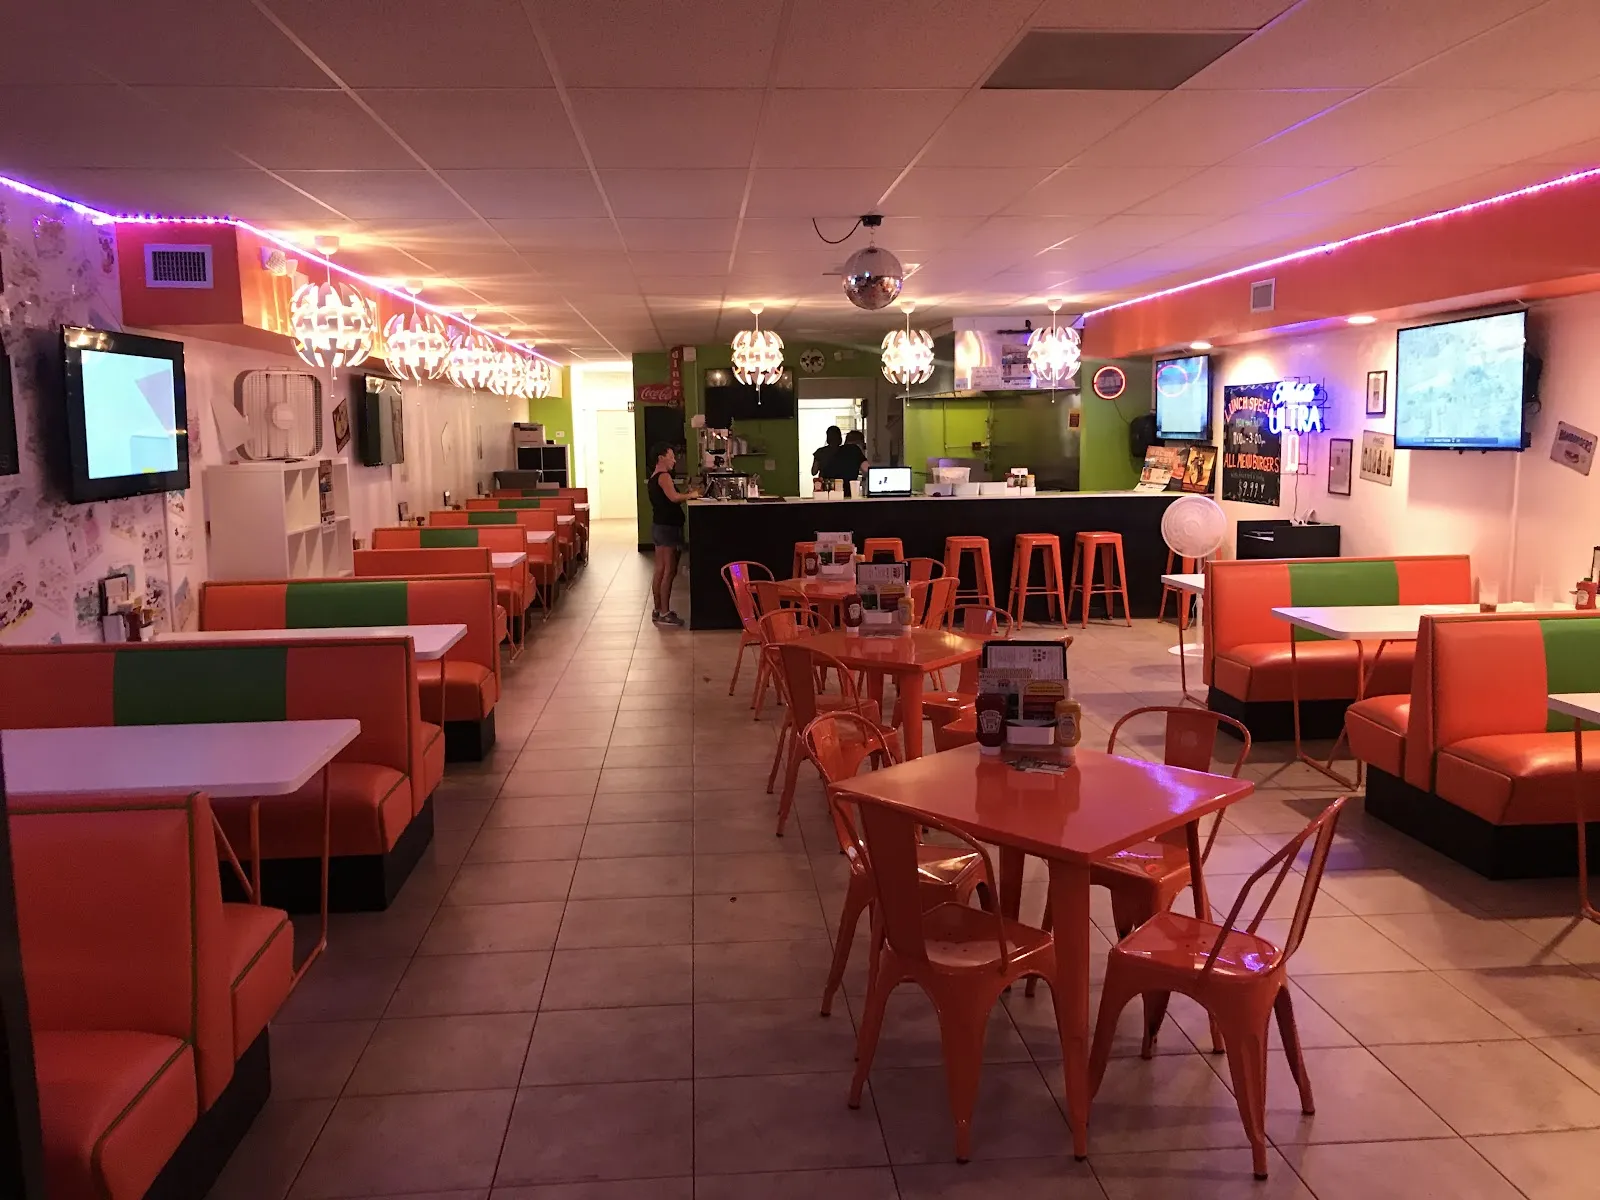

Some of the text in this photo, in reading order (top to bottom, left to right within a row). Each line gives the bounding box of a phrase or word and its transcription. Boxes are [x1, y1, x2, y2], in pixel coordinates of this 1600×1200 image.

[1224, 396, 1248, 423] LUNCH
[1268, 404, 1321, 435] ULTRA
[1224, 453, 1236, 468] ALL
[1252, 455, 1280, 473] BURGERS
